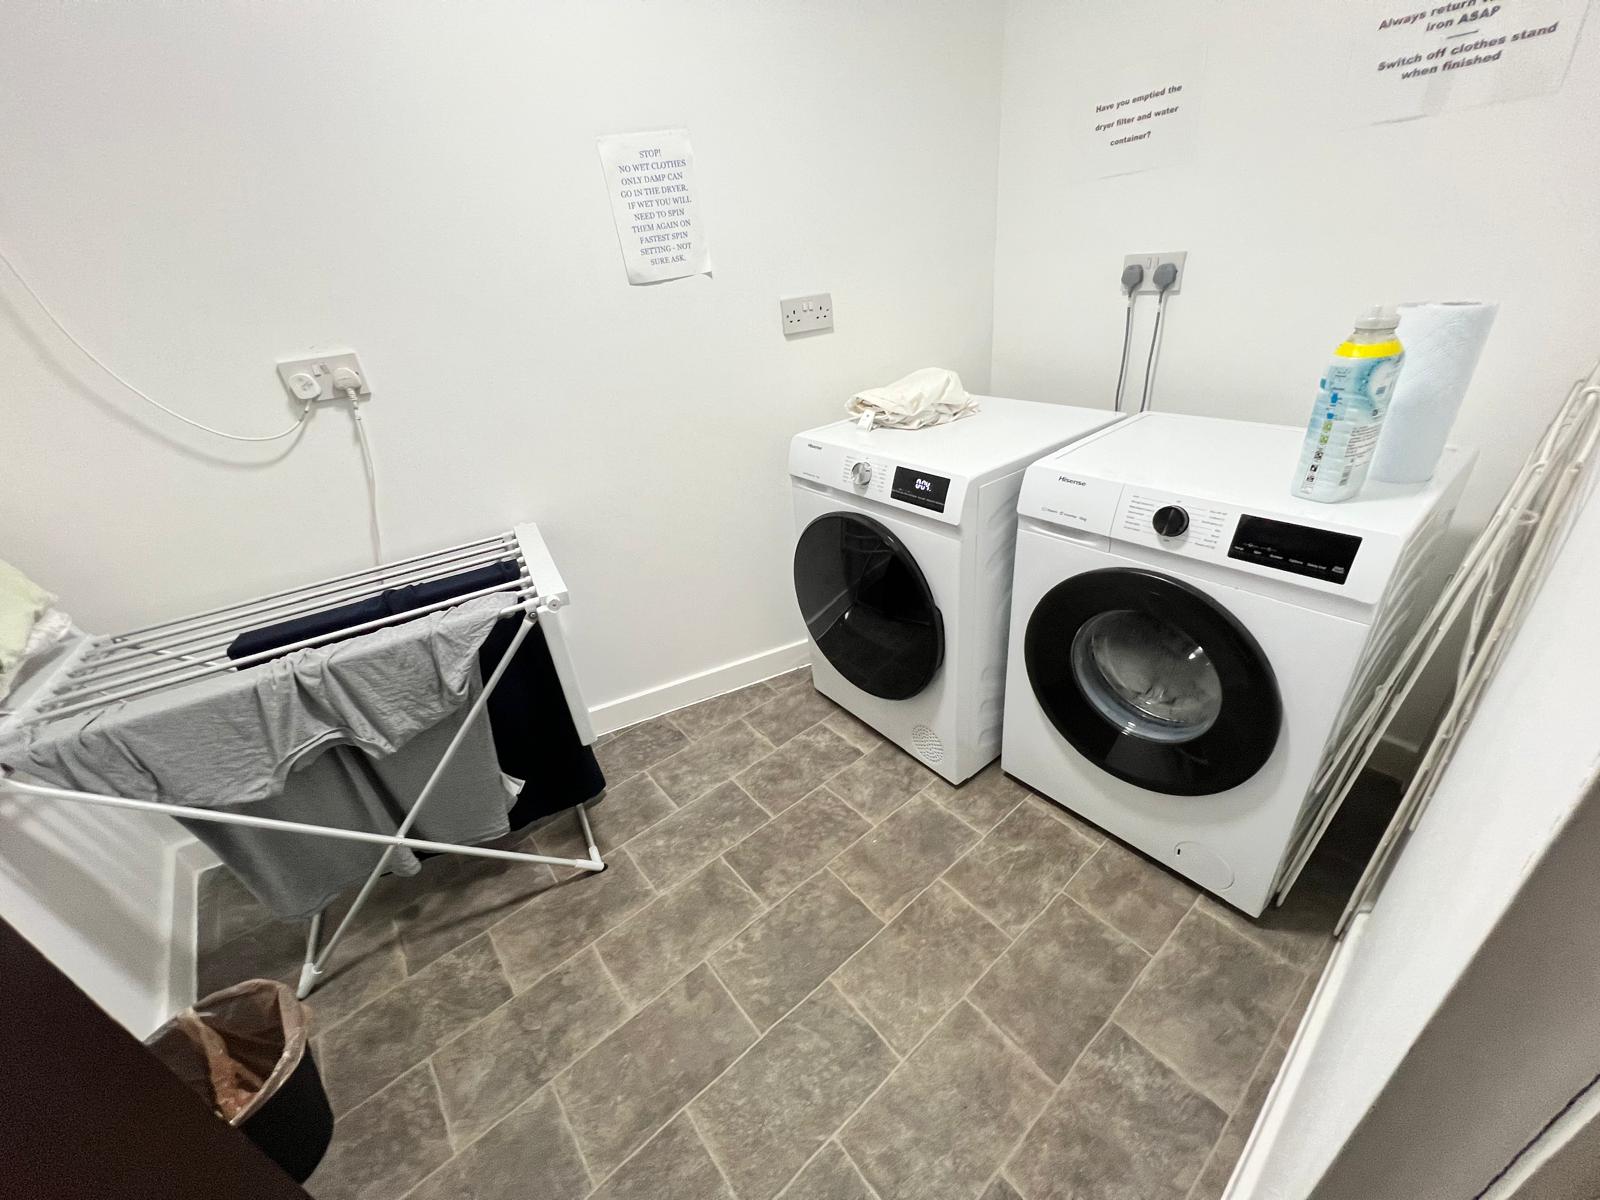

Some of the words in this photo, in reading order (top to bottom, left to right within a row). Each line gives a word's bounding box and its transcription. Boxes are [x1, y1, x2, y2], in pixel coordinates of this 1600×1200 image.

[1377, 12, 1427, 31] Always
[1431, 0, 1476, 16] return
[1426, 18, 1453, 32] iron
[1457, 5, 1500, 24] ASAP
[1377, 54, 1422, 71] Switch
[1427, 48, 1447, 60] off
[1451, 36, 1506, 55] clothes
[1511, 22, 1559, 42] stand
[1401, 64, 1437, 80] when
[1442, 50, 1502, 71] finished
[1096, 104, 1114, 113] Have
[1116, 100, 1130, 109] you
[1132, 88, 1165, 103] emptied
[1168, 85, 1182, 93] the
[1095, 122, 1114, 131] dryer
[1117, 117, 1135, 126] filter
[1137, 111, 1152, 121] and
[1154, 106, 1179, 117] water
[1110, 131, 1151, 146] container?
[639, 149, 661, 159] STOP!
[618, 165, 631, 174] NO
[632, 162, 649, 172] WET
[651, 159, 686, 170] CLOTHES
[621, 176, 642, 186] ONLY
[644, 174, 666, 183] DAMP
[667, 172, 683, 181] CAN
[621, 190, 632, 198] GO
[634, 189, 643, 197] IN
[644, 186, 660, 195] THE
[628, 201, 636, 210] IF
[638, 199, 654, 208] WET
[656, 198, 671, 206] YOU
[672, 196, 692, 204] WILL
[634, 212, 655, 221] NEED
[657, 210, 666, 218] TO
[668, 208, 685, 217] SPIN
[632, 223, 654, 233] THEM
[656, 221, 678, 231] AGAIN
[680, 219, 691, 227] ON
[640, 234, 670, 244] FASTEST
[671, 231, 688, 239] SPIN
[640, 245, 671, 256] SETTING
[677, 242, 692, 250] NOT
[650, 257, 670, 265] SURE
[1059, 476, 1086, 486] Hisense
